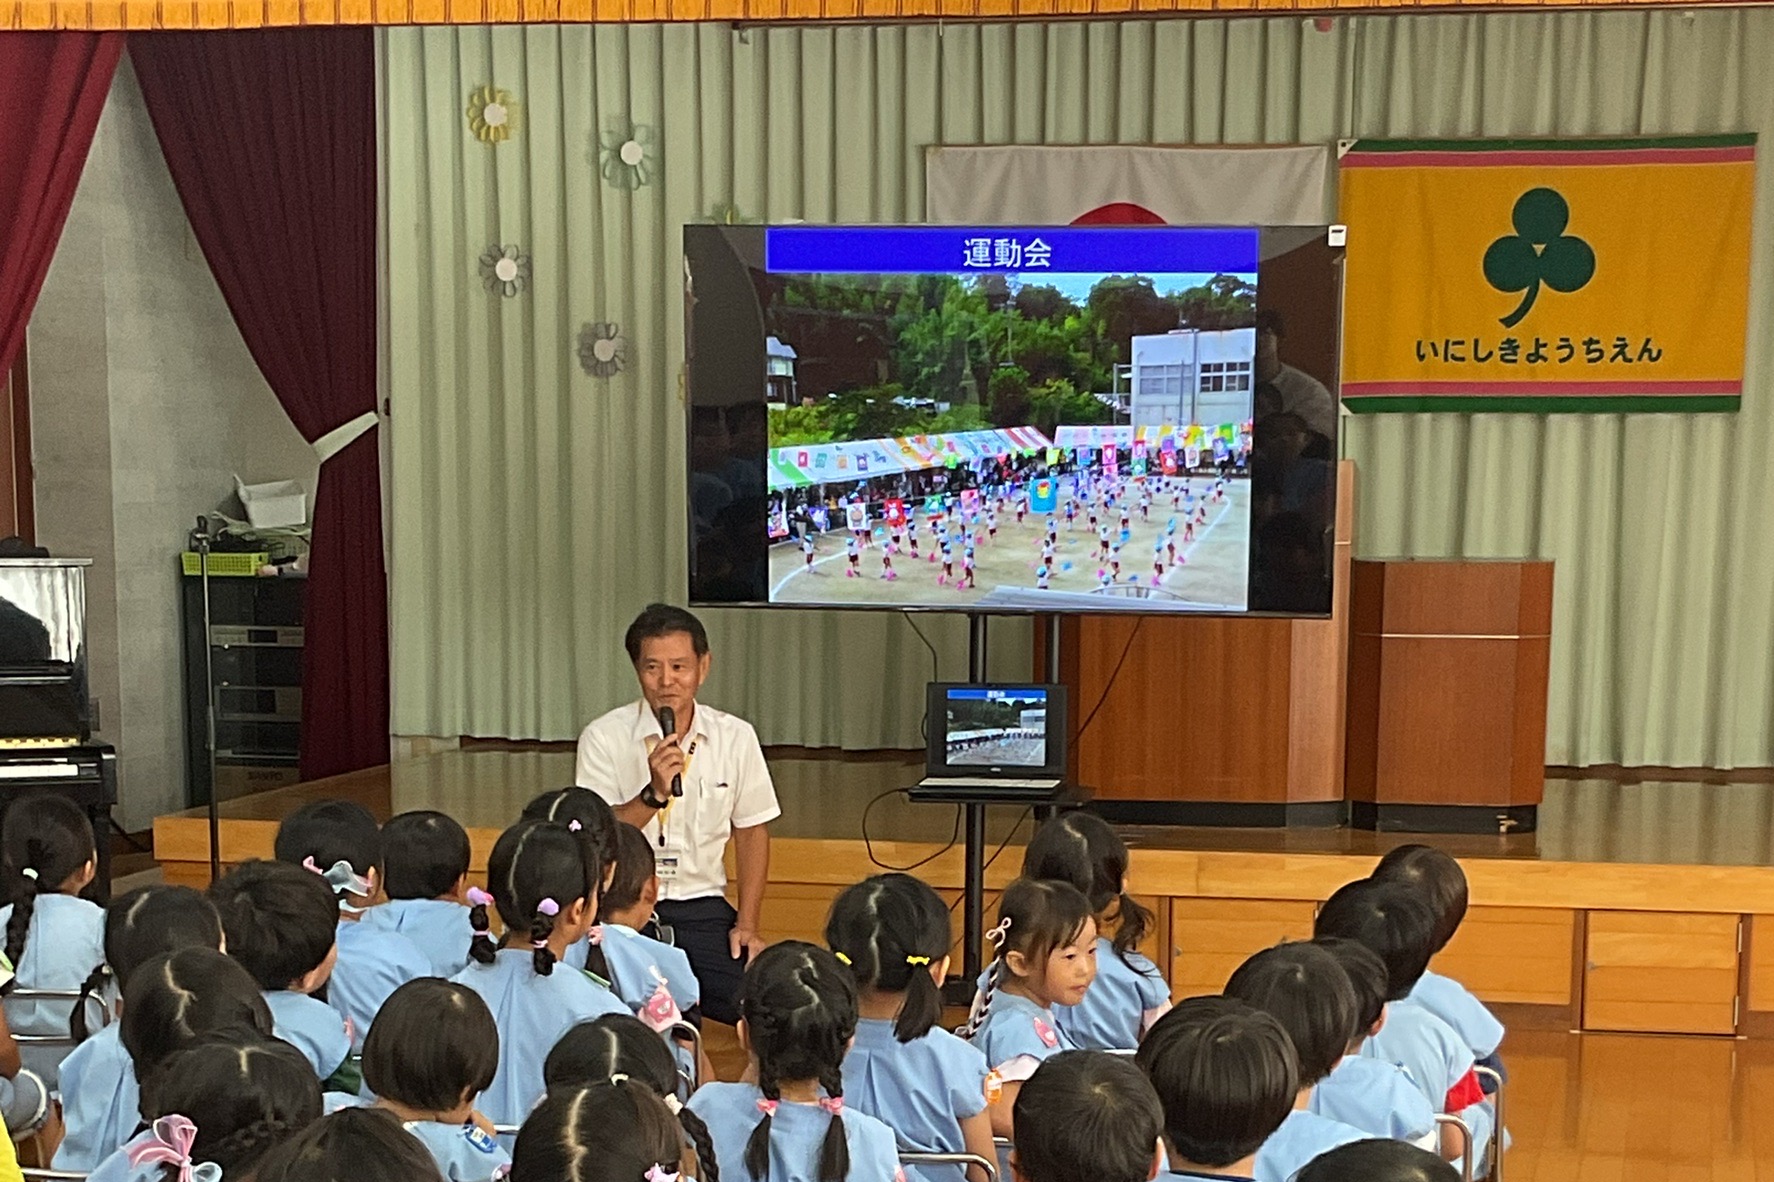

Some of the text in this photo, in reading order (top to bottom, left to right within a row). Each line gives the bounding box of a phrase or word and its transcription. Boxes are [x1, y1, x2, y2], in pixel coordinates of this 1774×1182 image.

[963, 238, 1052, 268] 運動会
[1415, 336, 1663, 364] いにしきようちえん
